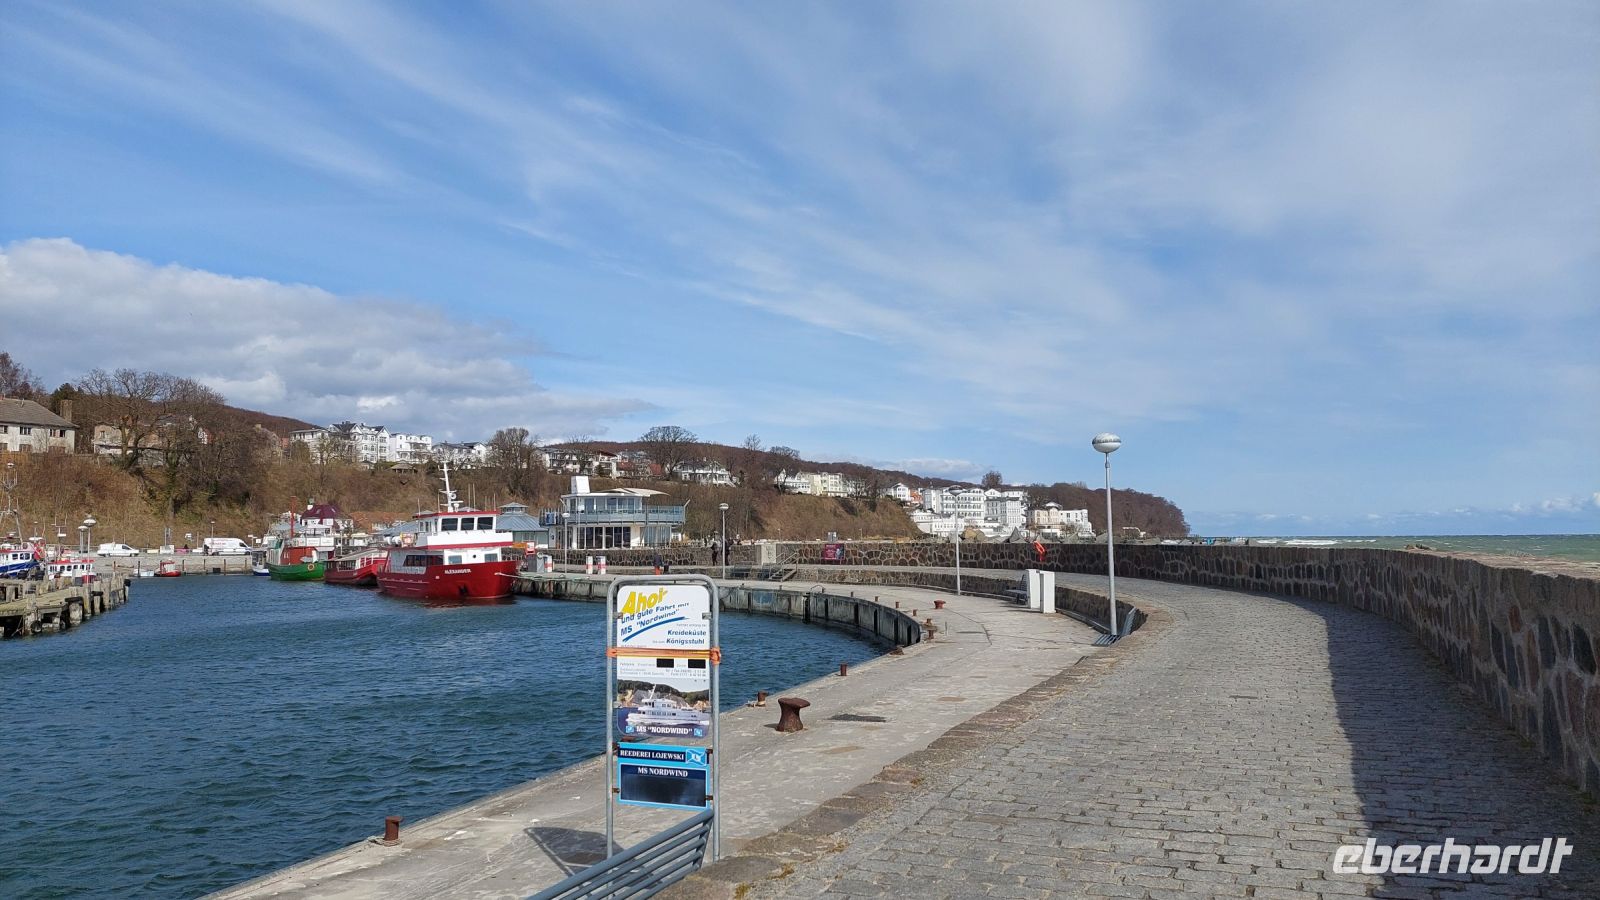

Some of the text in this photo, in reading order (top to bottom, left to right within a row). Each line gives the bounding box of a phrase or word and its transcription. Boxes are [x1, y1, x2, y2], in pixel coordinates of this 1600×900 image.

[621, 613, 635, 624] und
[637, 608, 654, 620] gute
[655, 603, 676, 613] Fahrt
[620, 625, 632, 636] MS
[666, 637, 705, 646] Königsstuhl
[620, 749, 684, 760] REEDEREI LOJEWSKI
[649, 768, 688, 777] NORDWIND
